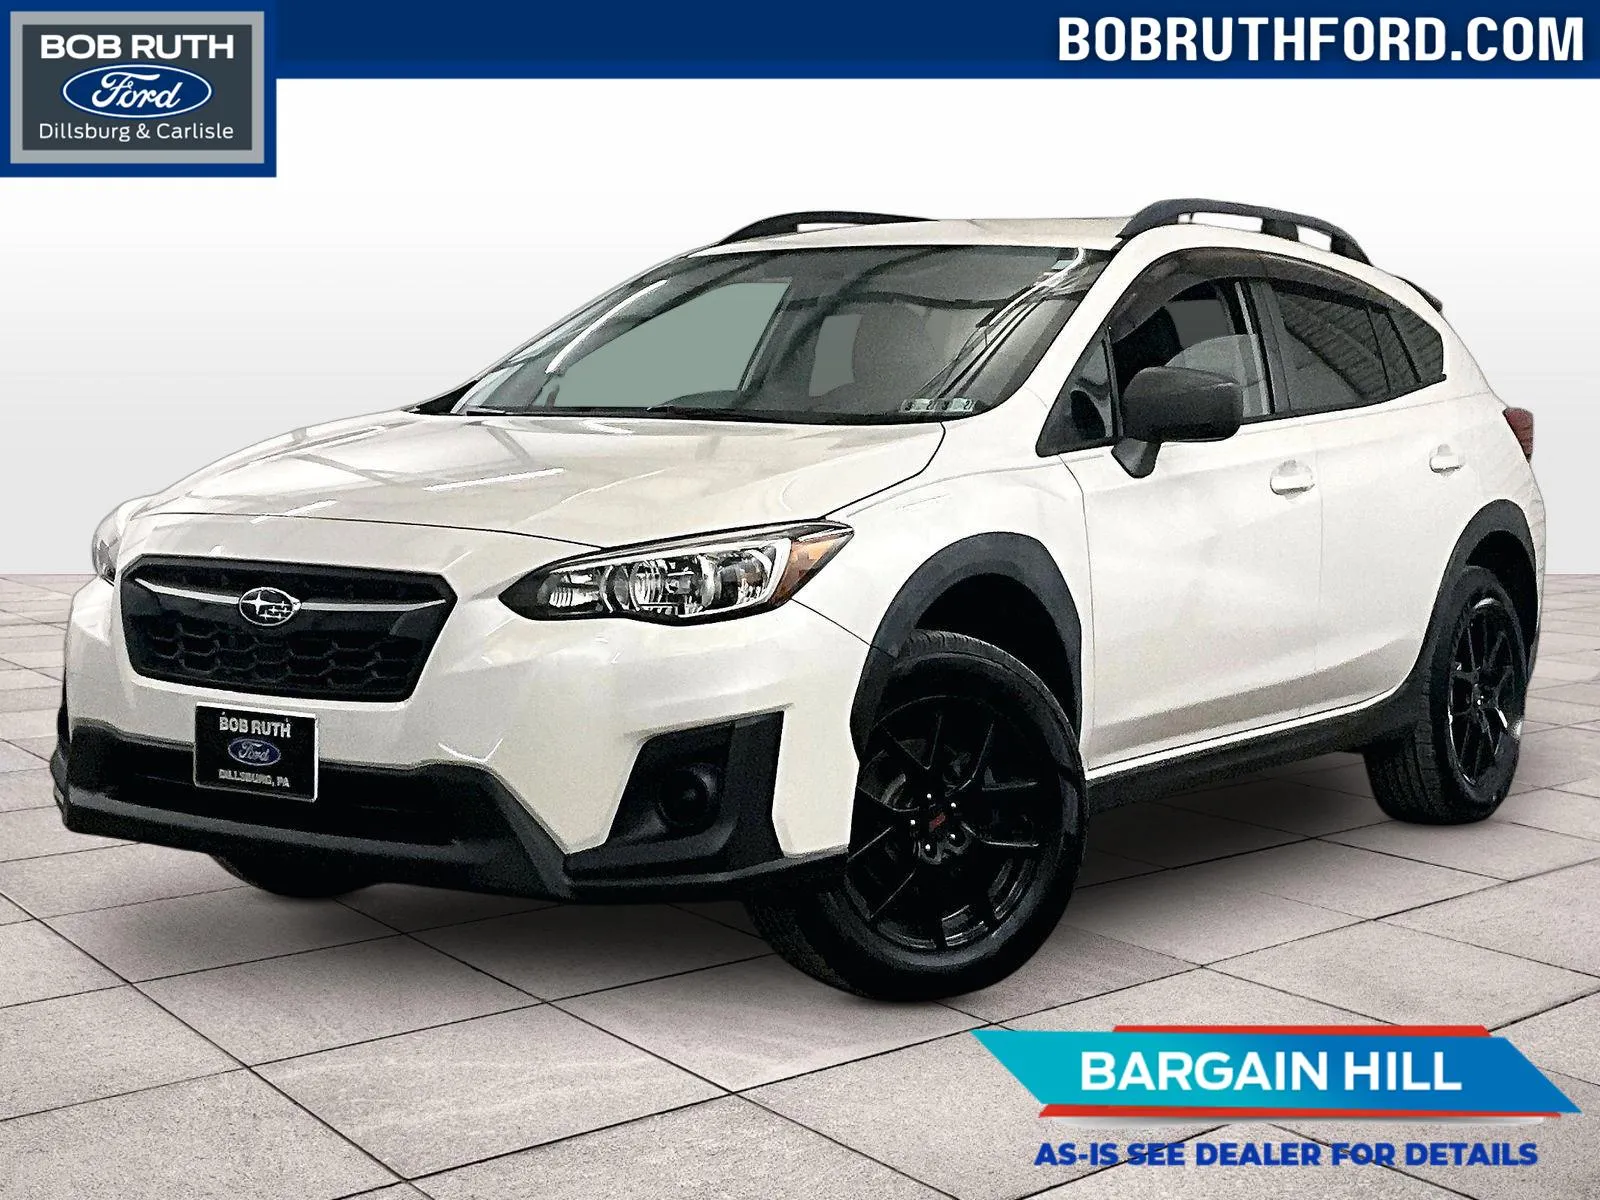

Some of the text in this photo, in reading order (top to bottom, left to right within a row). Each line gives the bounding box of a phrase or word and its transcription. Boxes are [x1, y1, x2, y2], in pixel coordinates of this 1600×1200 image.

[219, 716, 292, 738] BOB RUTH
[238, 741, 271, 762] Ford
[276, 776, 290, 788] PA
